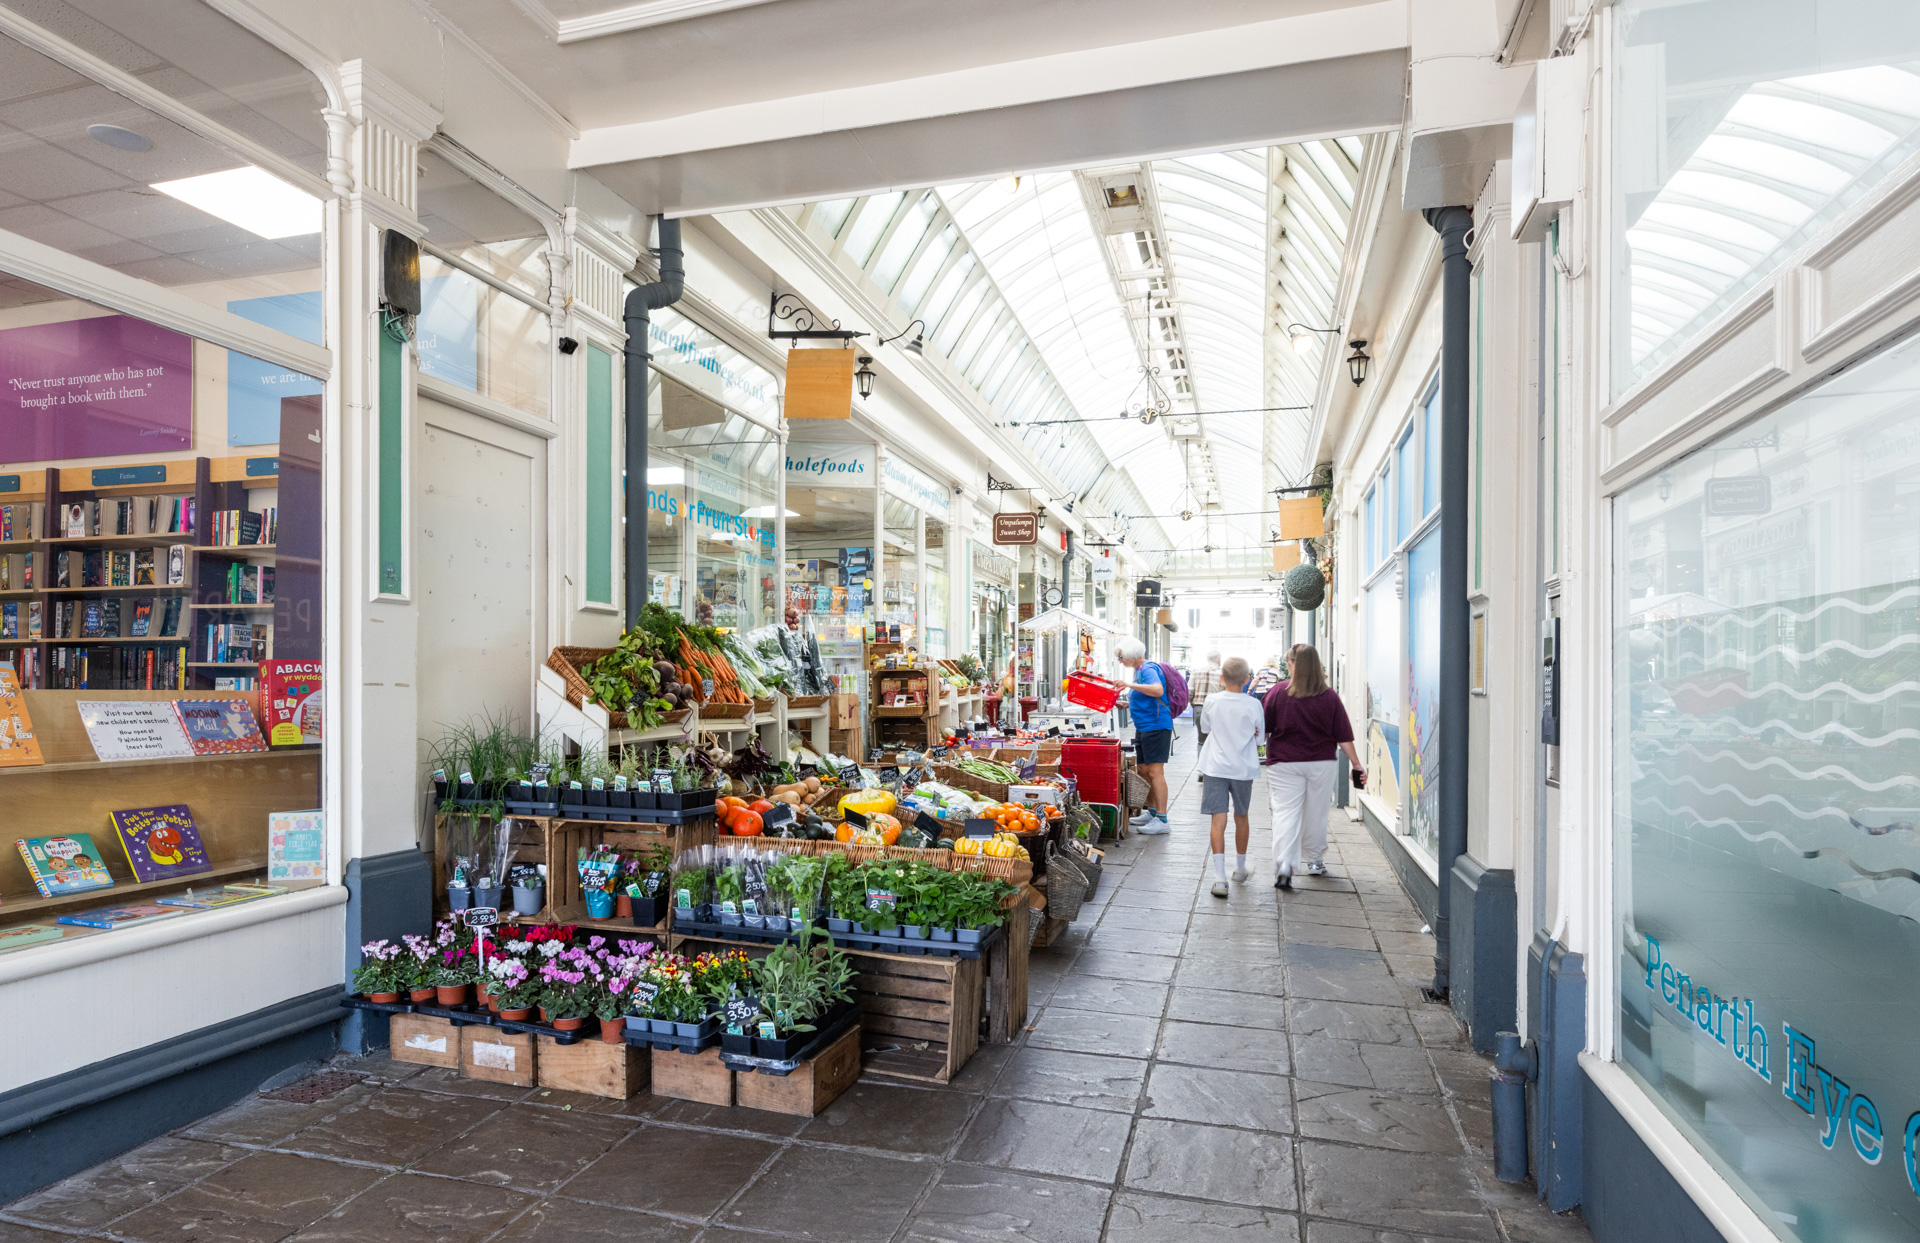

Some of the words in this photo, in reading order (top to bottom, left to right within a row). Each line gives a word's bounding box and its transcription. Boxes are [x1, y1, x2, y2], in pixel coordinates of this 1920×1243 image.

[649, 322, 765, 403] narthfruitveg.co.uk
[44, 376, 65, 388] trust
[67, 372, 101, 388] anyone
[103, 368, 125, 382] who
[127, 366, 144, 379] has
[146, 365, 164, 377] not
[261, 375, 277, 385] we
[279, 373, 297, 383] are
[20, 393, 58, 410] brought
[60, 396, 66, 405] a
[68, 390, 92, 404] book
[94, 387, 116, 401] with
[119, 472, 136, 480] Fiction
[697, 501, 731, 533] Fruit
[1017, 528, 1031, 536] Shop
[791, 590, 829, 602] Delivery
[283, 675, 292, 683] yr
[184, 709, 221, 719] MOOMIN
[193, 719, 219, 731] Mail
[124, 814, 140, 826] Put
[126, 817, 151, 837] Botty
[163, 813, 192, 828] Potty!
[288, 840, 303, 848] FIRST
[51, 847, 79, 856] Nappies
[745, 882, 761, 893] 2.50
[470, 914, 489, 924] 2.99
[727, 1006, 752, 1021] 3.50
[1645, 932, 1771, 1085] Penarth
[1783, 1020, 1883, 1166] Eye
